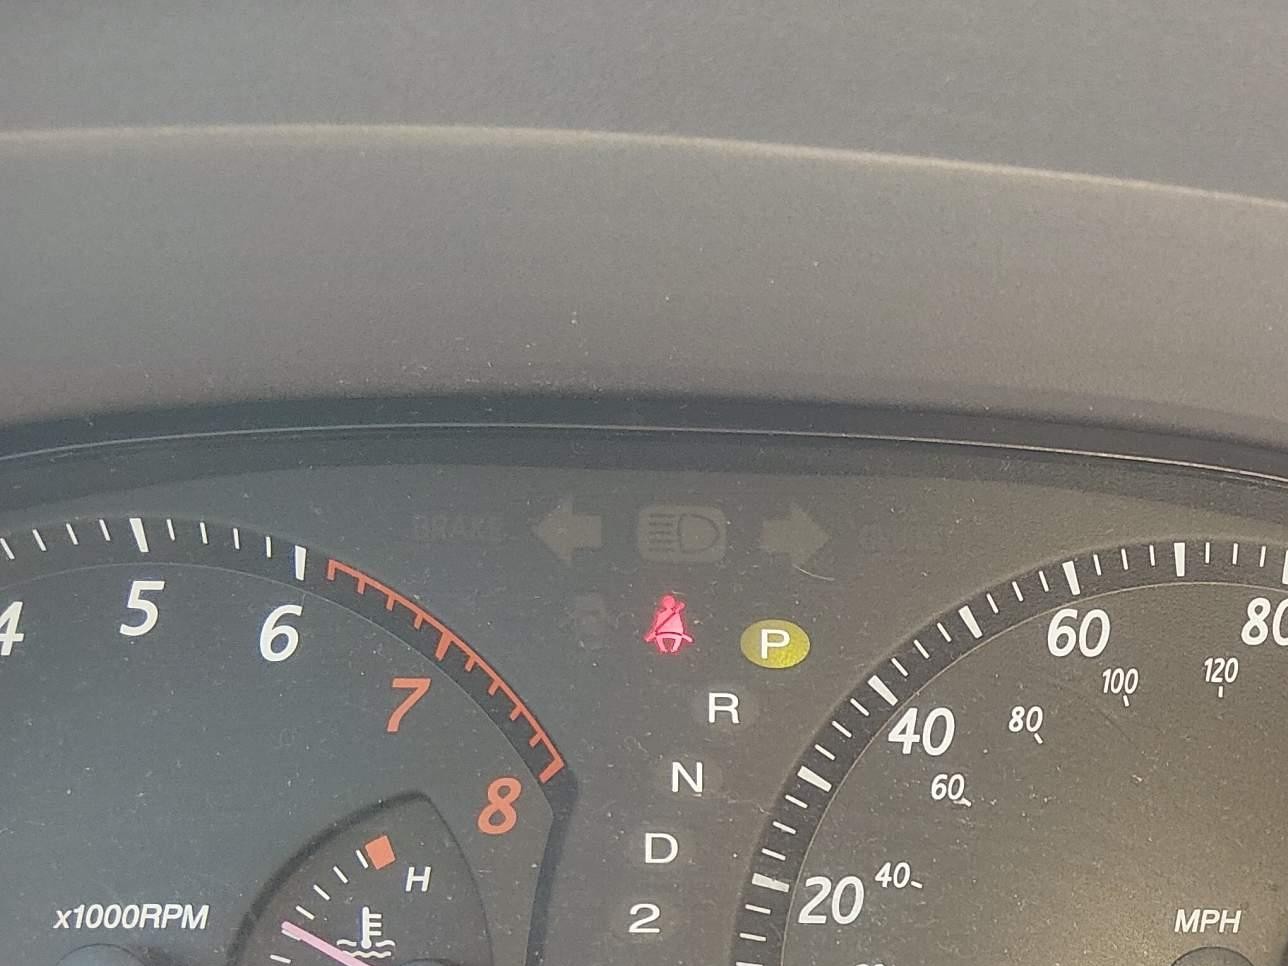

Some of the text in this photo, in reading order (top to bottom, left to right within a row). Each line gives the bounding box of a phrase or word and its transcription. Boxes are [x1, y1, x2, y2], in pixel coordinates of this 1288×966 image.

[120, 581, 164, 636] 5
[0, 601, 24, 656] 4
[259, 605, 302, 662] 6
[1047, 608, 1110, 657] 60
[760, 629, 791, 659] P
[1102, 668, 1139, 694] 100
[1204, 657, 1239, 683] 120
[387, 678, 431, 732] 7
[708, 693, 740, 724] R
[1008, 706, 1043, 733] 80
[887, 707, 955, 755] 40
[672, 762, 703, 792] N
[931, 774, 965, 800] 60
[477, 778, 521, 835] 8
[645, 833, 678, 863] D
[405, 867, 431, 892] H
[875, 863, 910, 888] 40
[799, 876, 864, 925] 20
[53, 904, 209, 930] x1000RPM
[629, 904, 660, 933] 2
[1174, 909, 1241, 934] MPH
